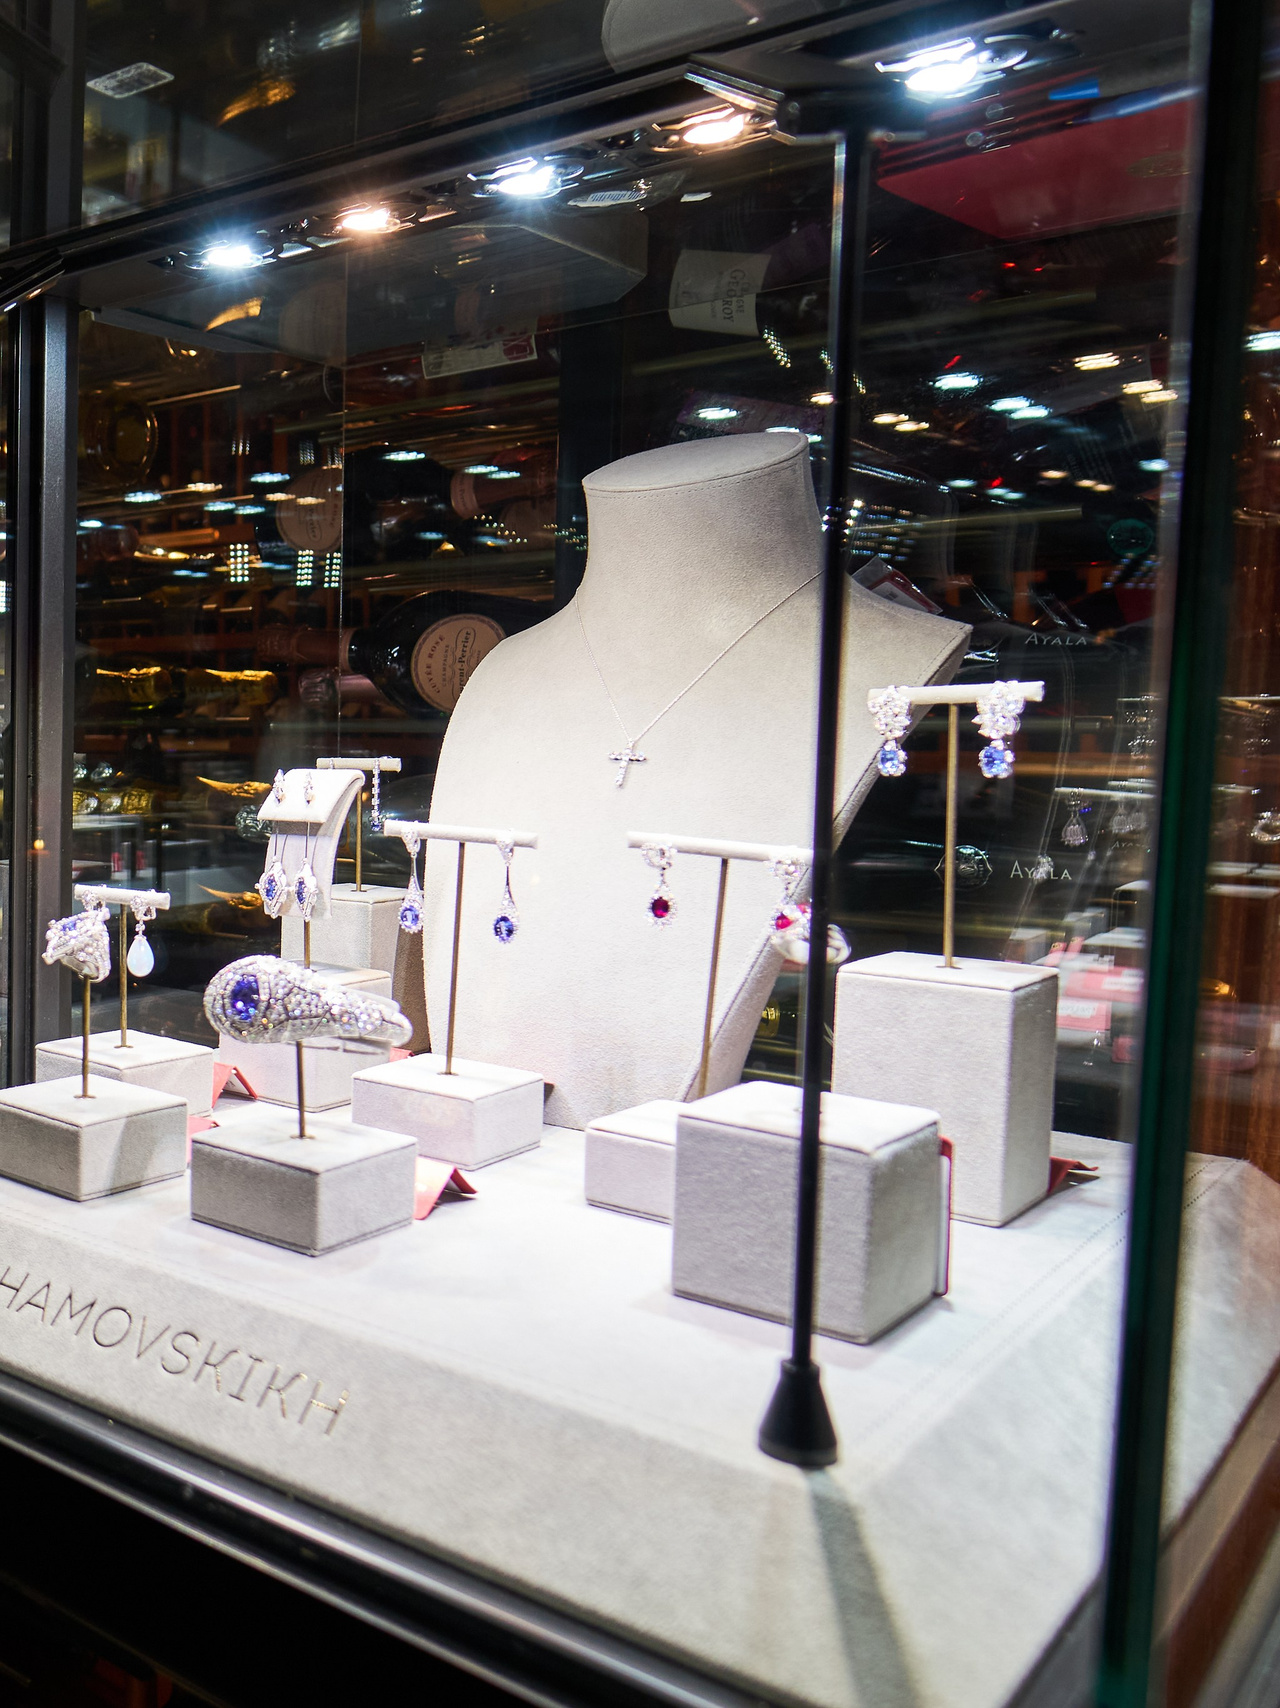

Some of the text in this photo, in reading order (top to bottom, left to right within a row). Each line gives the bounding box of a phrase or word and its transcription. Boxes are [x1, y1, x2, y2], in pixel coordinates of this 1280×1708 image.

[1025, 632, 1088, 647] AYALA
[424, 661, 441, 694] CUVÉE
[442, 643, 450, 687] CHAMPAGNE
[457, 630, 471, 694] urent-Perrier
[1010, 859, 1073, 881] AYALA
